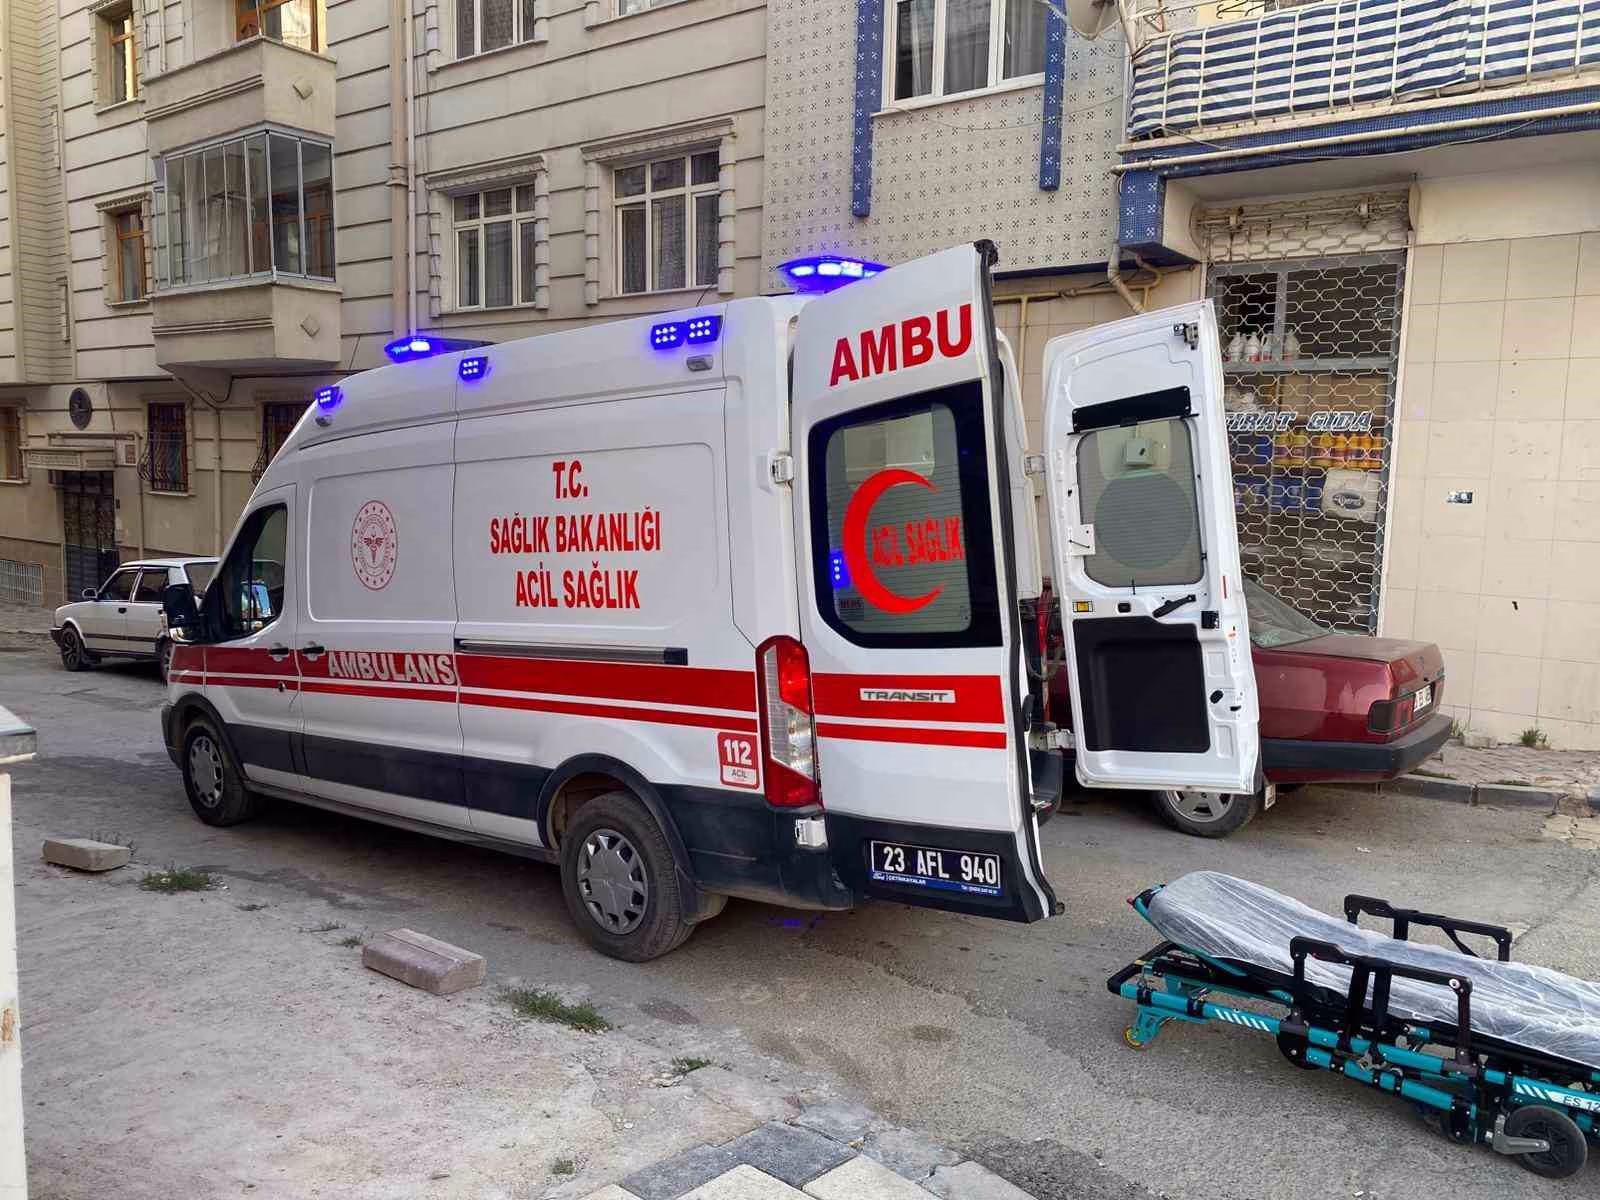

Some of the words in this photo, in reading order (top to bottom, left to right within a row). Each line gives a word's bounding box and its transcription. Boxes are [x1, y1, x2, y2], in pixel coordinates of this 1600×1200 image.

[829, 303, 973, 387] AMBU
[1307, 411, 1373, 431] GIDA
[552, 460, 589, 499] T.C.
[490, 511, 550, 554] SAĞLIK
[555, 505, 661, 553] BAKANLIĞI
[516, 561, 559, 608] ACİL
[562, 560, 641, 609] SAĞLIK
[327, 651, 456, 685] AMBULANS
[862, 690, 951, 702] TRANSIT
[723, 738, 753, 766] 112
[883, 845, 906, 873] 23
[916, 849, 950, 879] AFL
[959, 854, 997, 885] 940
[1563, 1095, 1582, 1107] ES
